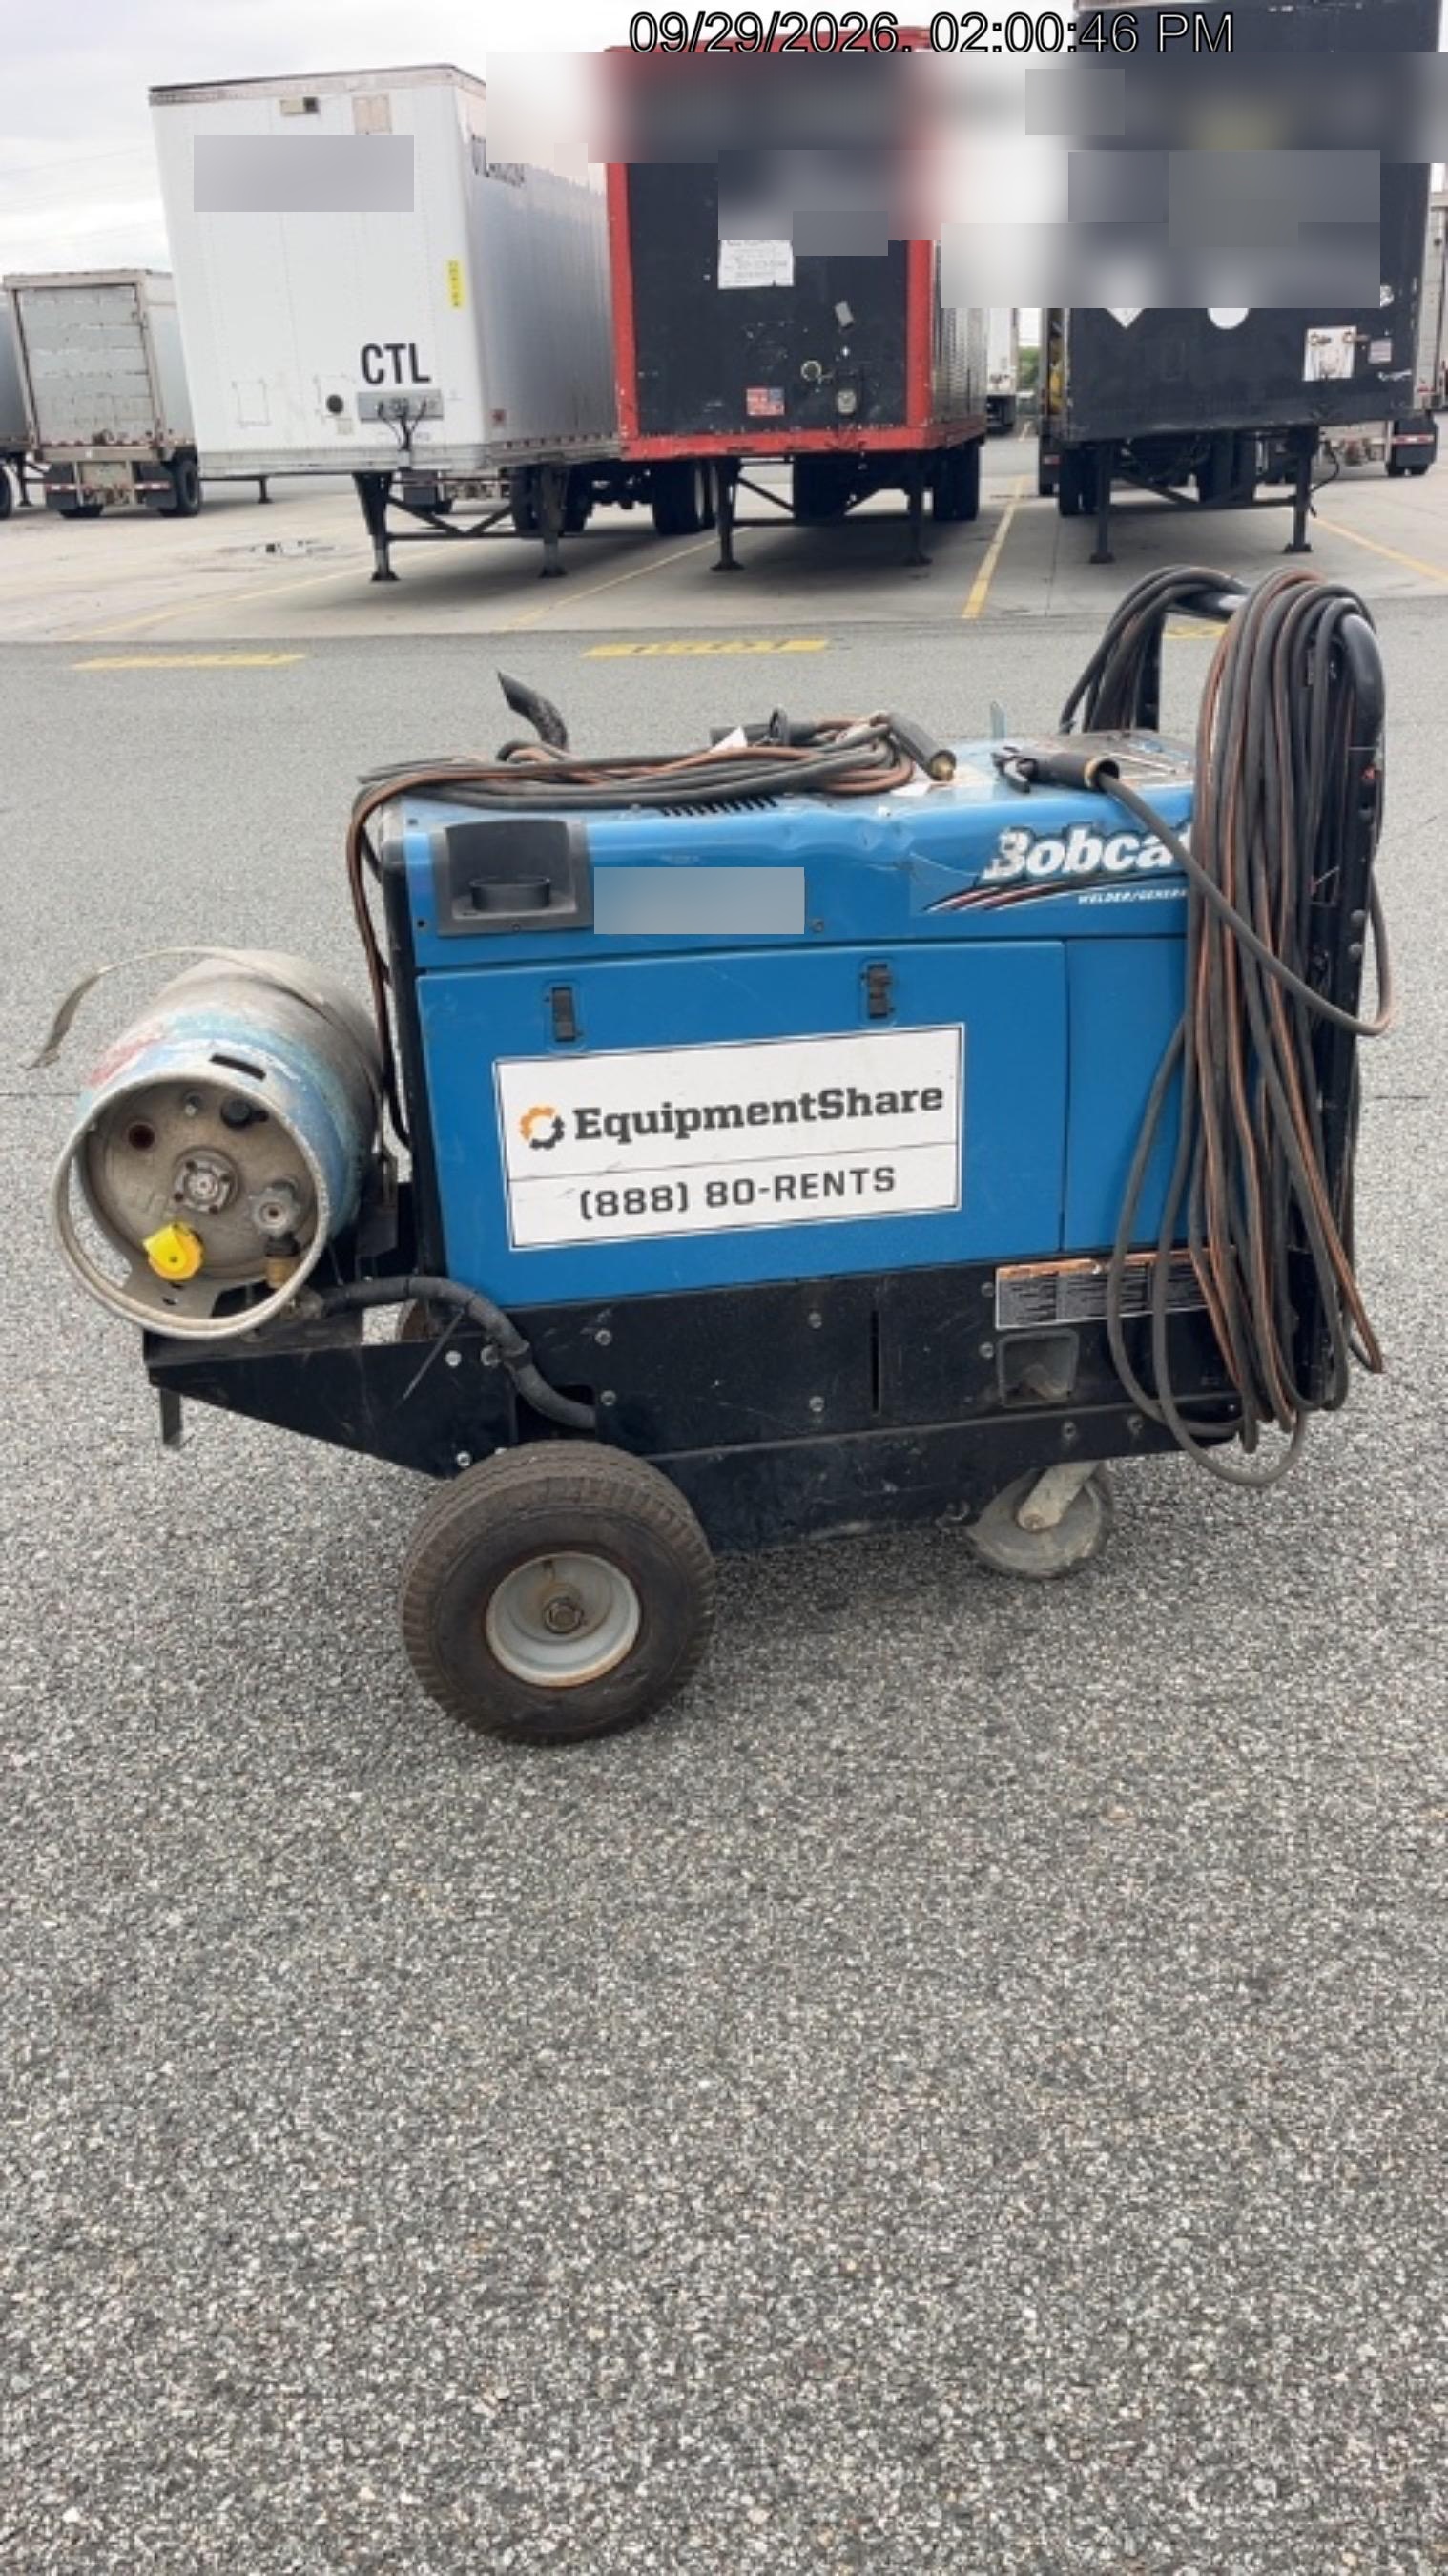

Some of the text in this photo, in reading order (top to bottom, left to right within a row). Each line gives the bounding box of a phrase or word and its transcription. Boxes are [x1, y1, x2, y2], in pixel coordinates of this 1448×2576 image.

[361, 343, 431, 384] CTL
[574, 1087, 943, 1144] EquipmentShare
[580, 1166, 896, 1220] (888) 80-RENTS
